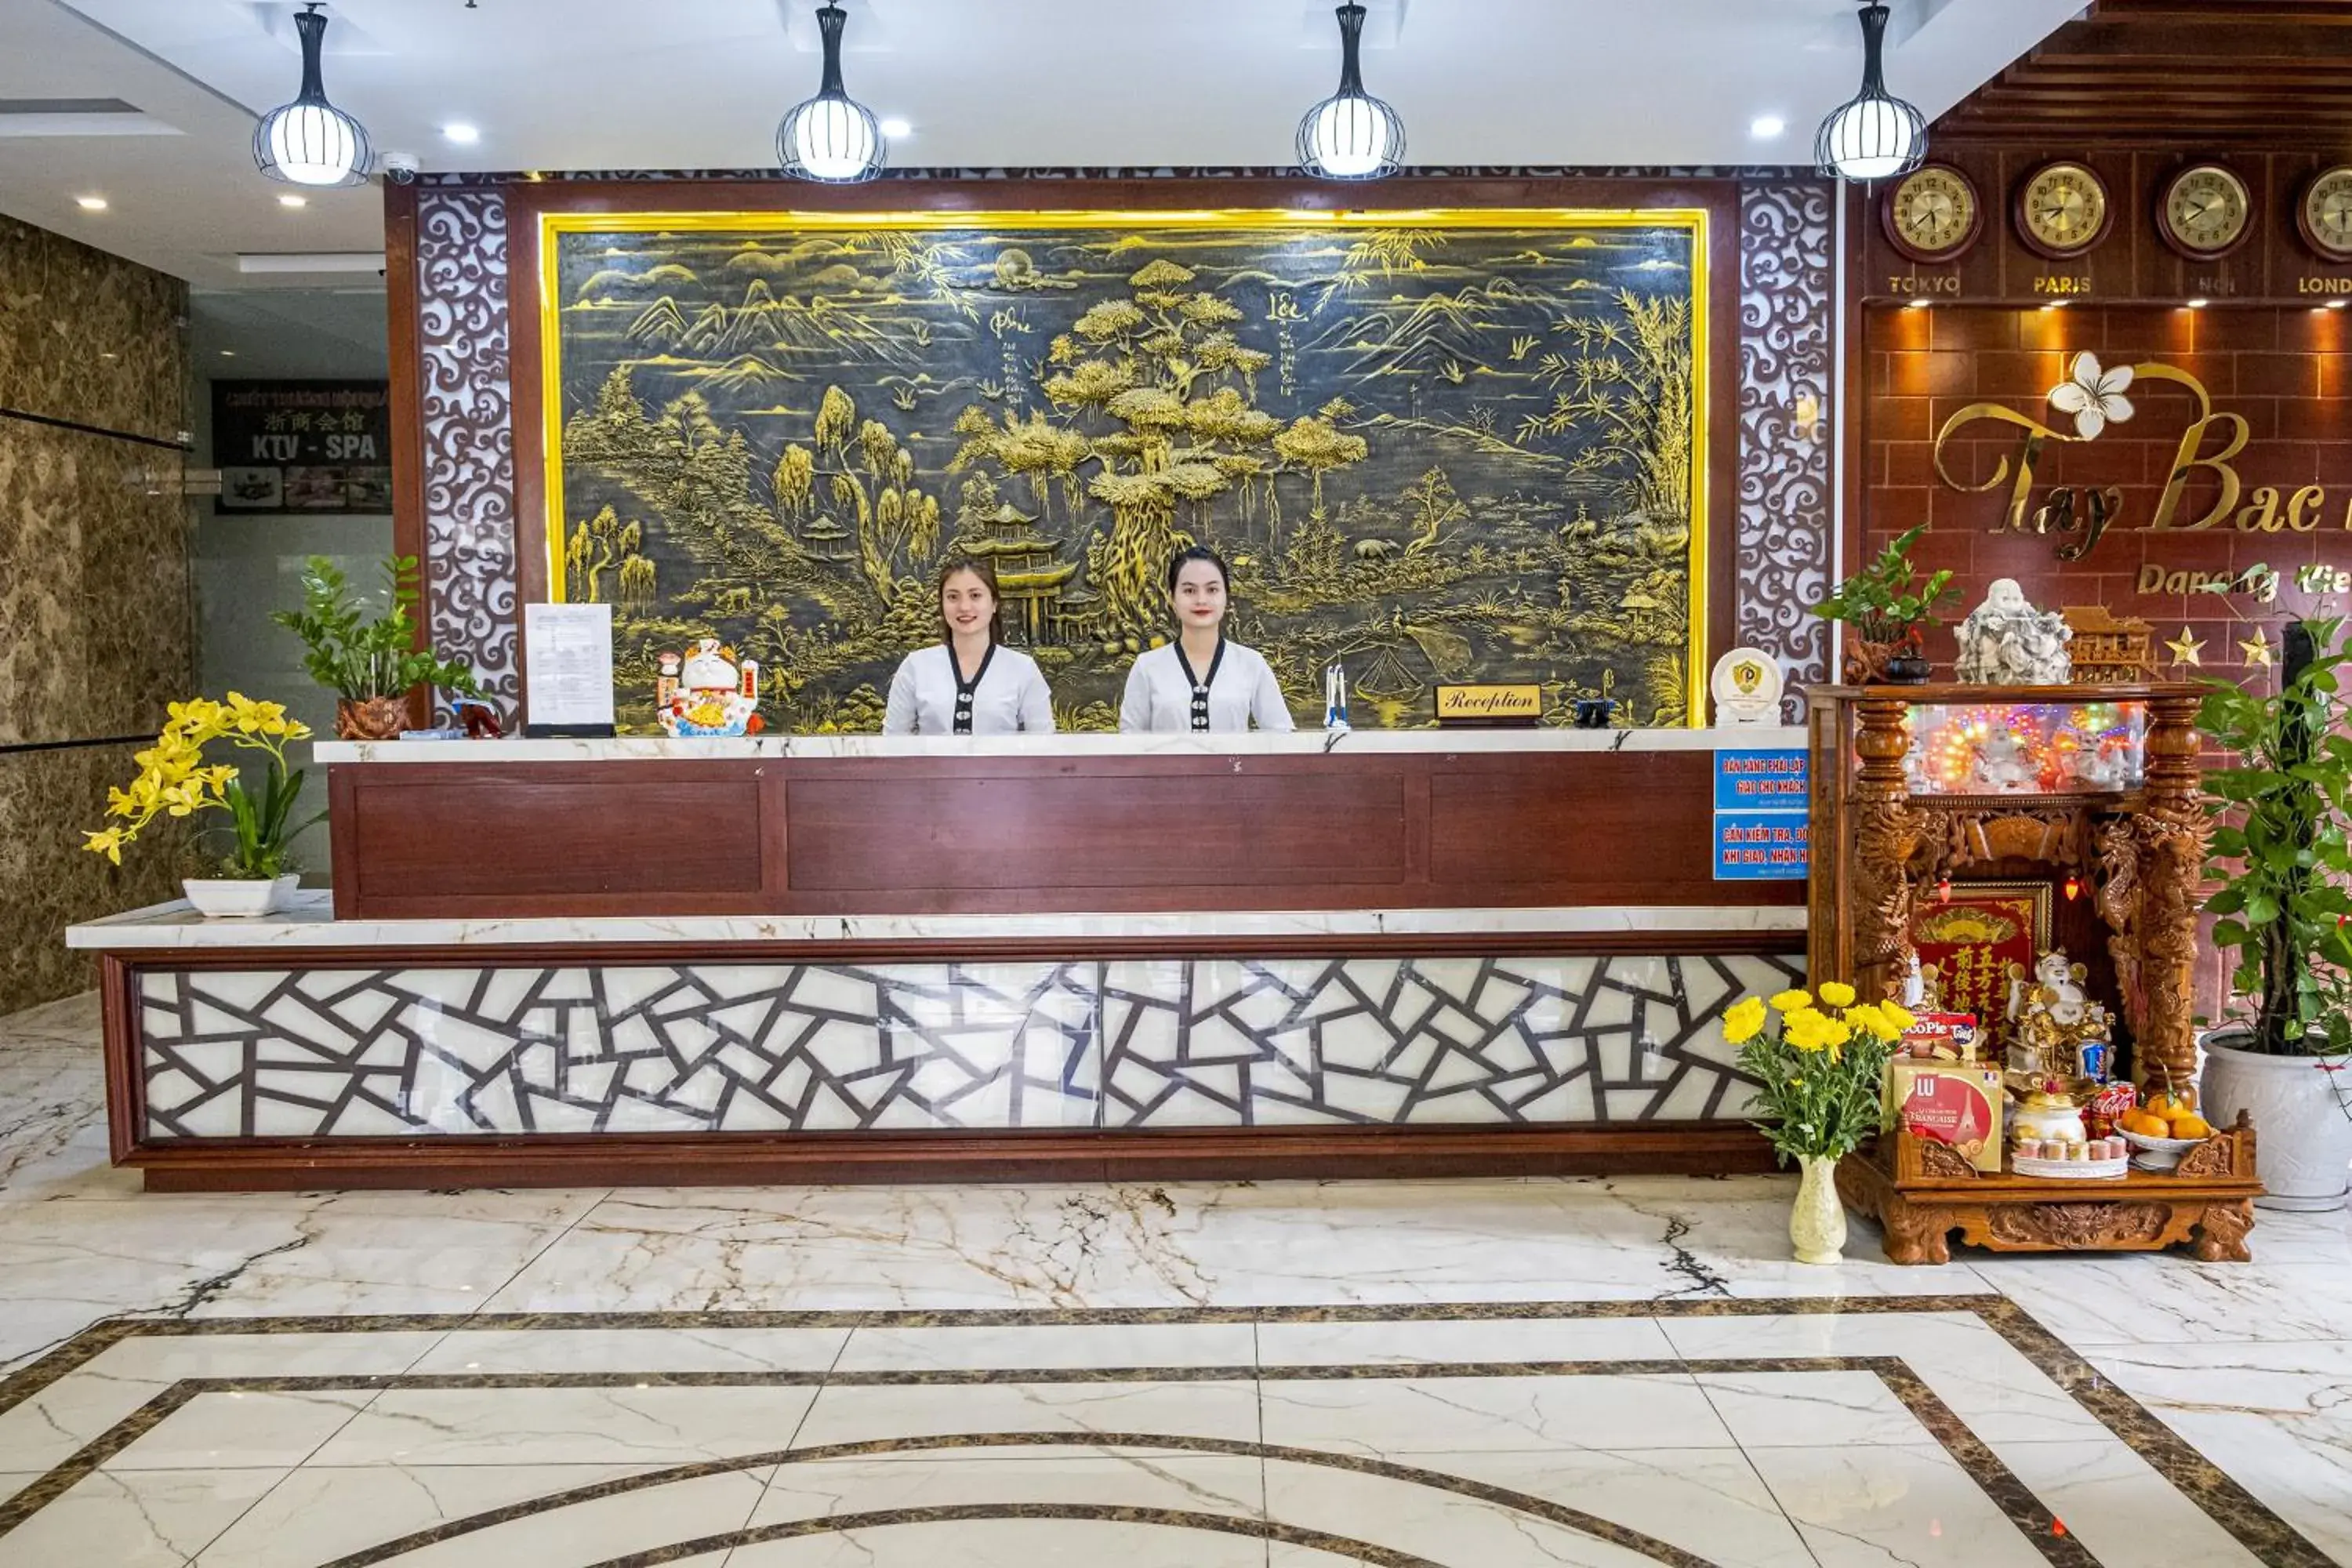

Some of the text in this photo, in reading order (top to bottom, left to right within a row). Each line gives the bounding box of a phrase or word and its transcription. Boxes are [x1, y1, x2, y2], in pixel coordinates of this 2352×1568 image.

[1888, 277, 1958, 292] TOKYO
[2034, 277, 2092, 293] PARIS
[252, 434, 299, 460] KTV
[326, 434, 376, 459] SPA
[1933, 362, 2325, 561] Tay Bac
[1445, 690, 1534, 712] Reception
[1917, 1078, 1934, 1097] LU
